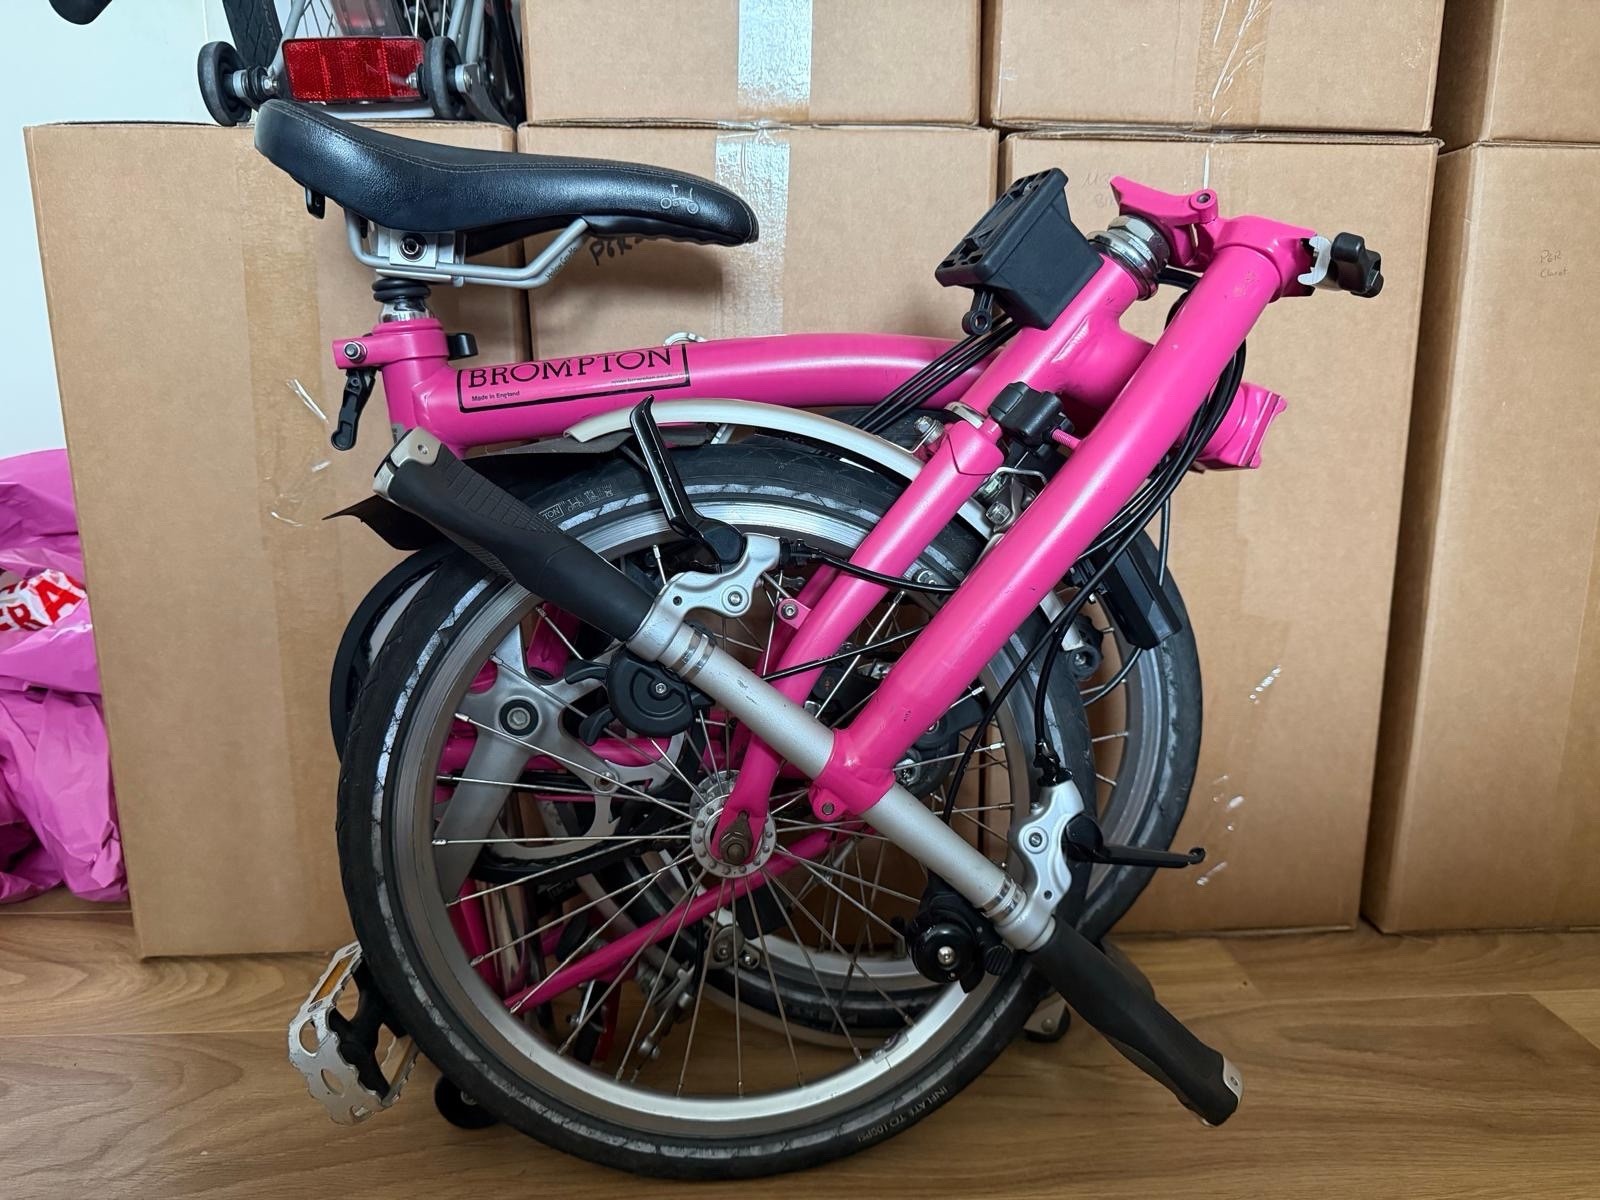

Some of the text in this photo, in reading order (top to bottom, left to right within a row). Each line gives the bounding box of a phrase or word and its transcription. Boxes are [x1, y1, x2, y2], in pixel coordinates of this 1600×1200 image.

[467, 346, 673, 389] BROMPTON
[471, 394, 489, 402] Made
[496, 389, 521, 399] England
[541, 506, 562, 520] TON
